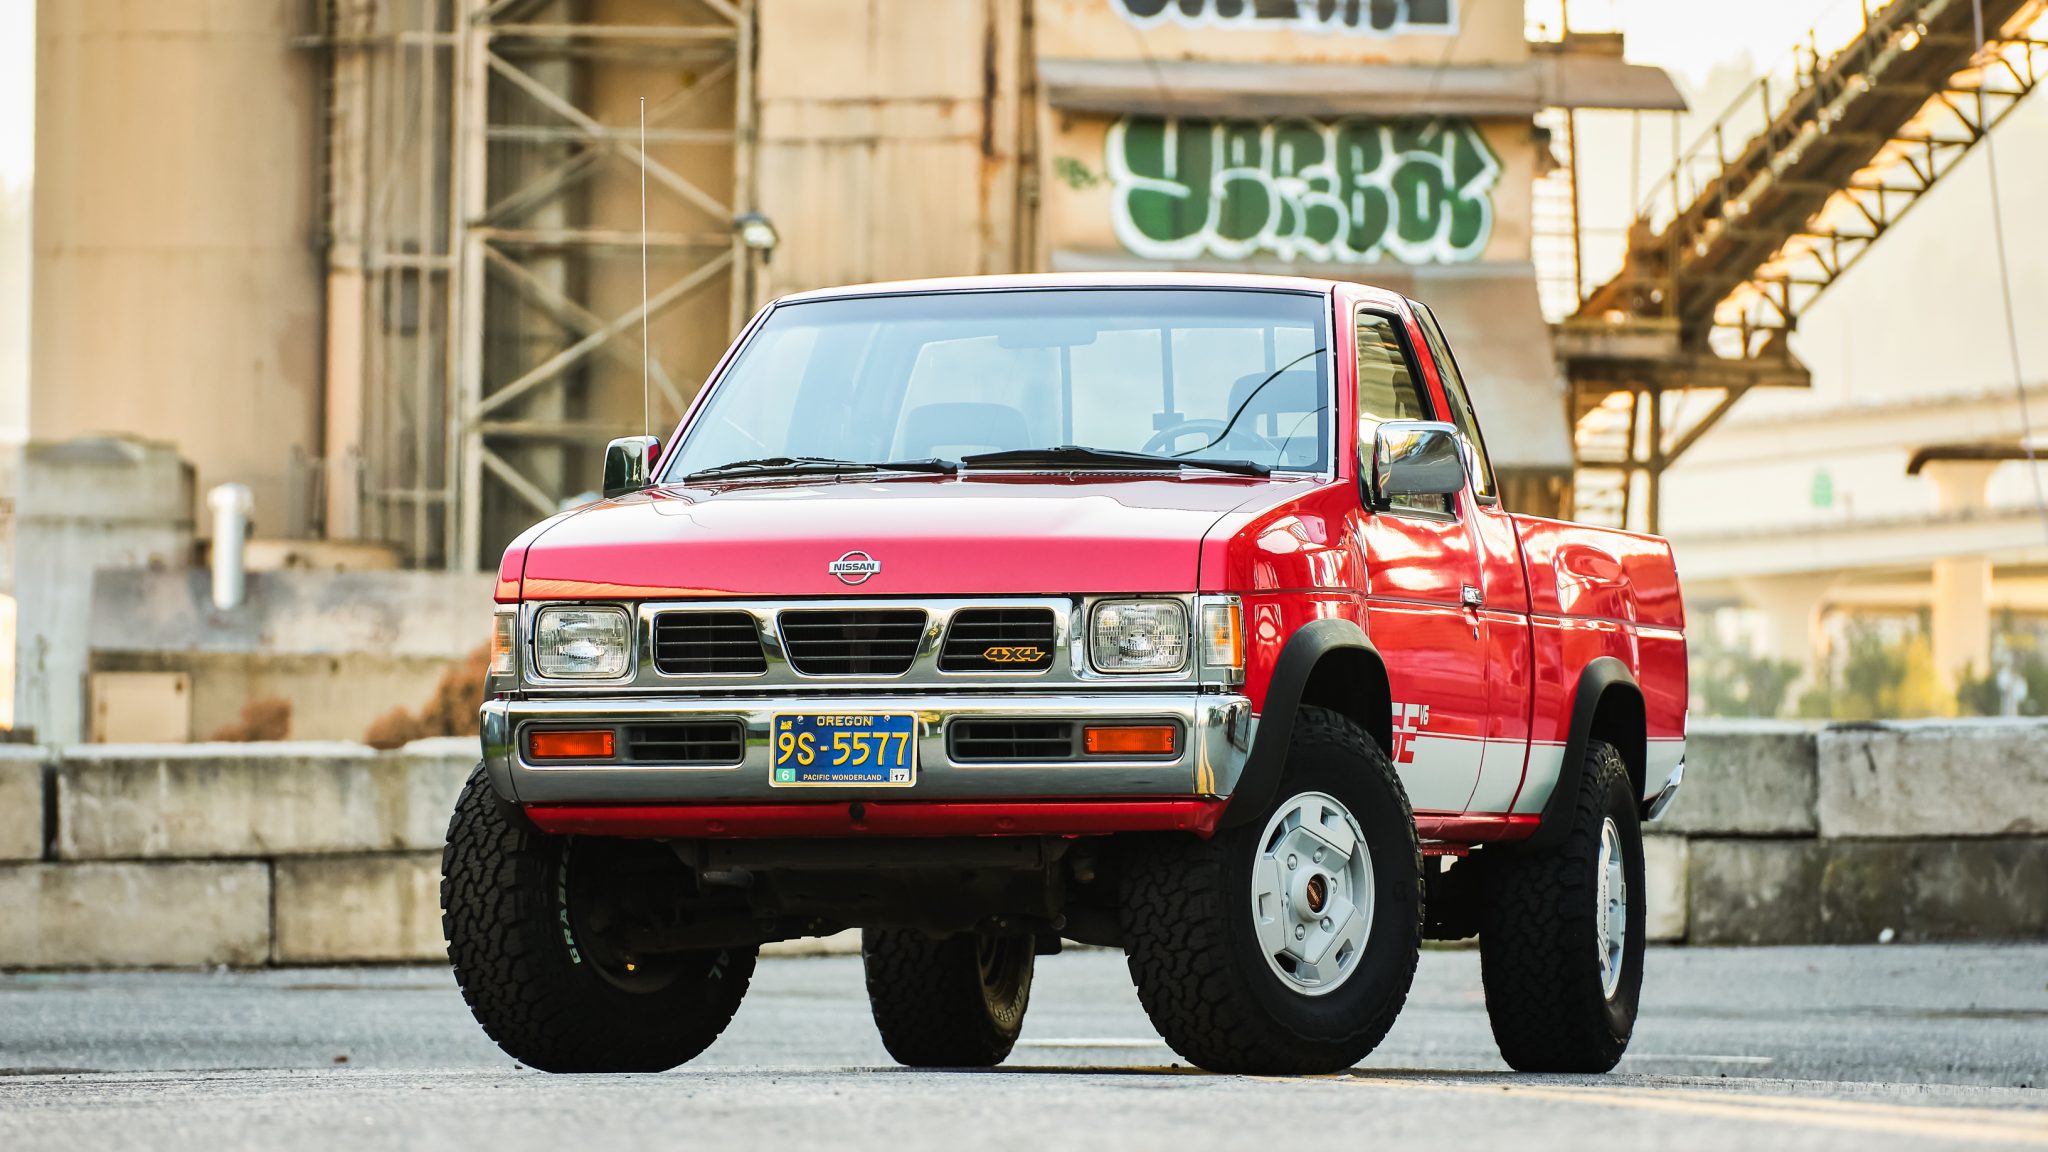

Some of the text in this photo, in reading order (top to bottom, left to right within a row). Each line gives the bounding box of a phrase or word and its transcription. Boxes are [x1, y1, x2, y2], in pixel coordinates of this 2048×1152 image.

[834, 563, 875, 571] NISSAN
[816, 715, 874, 727] OREGON
[778, 732, 910, 766] 9S-5577
[781, 770, 790, 781] 6
